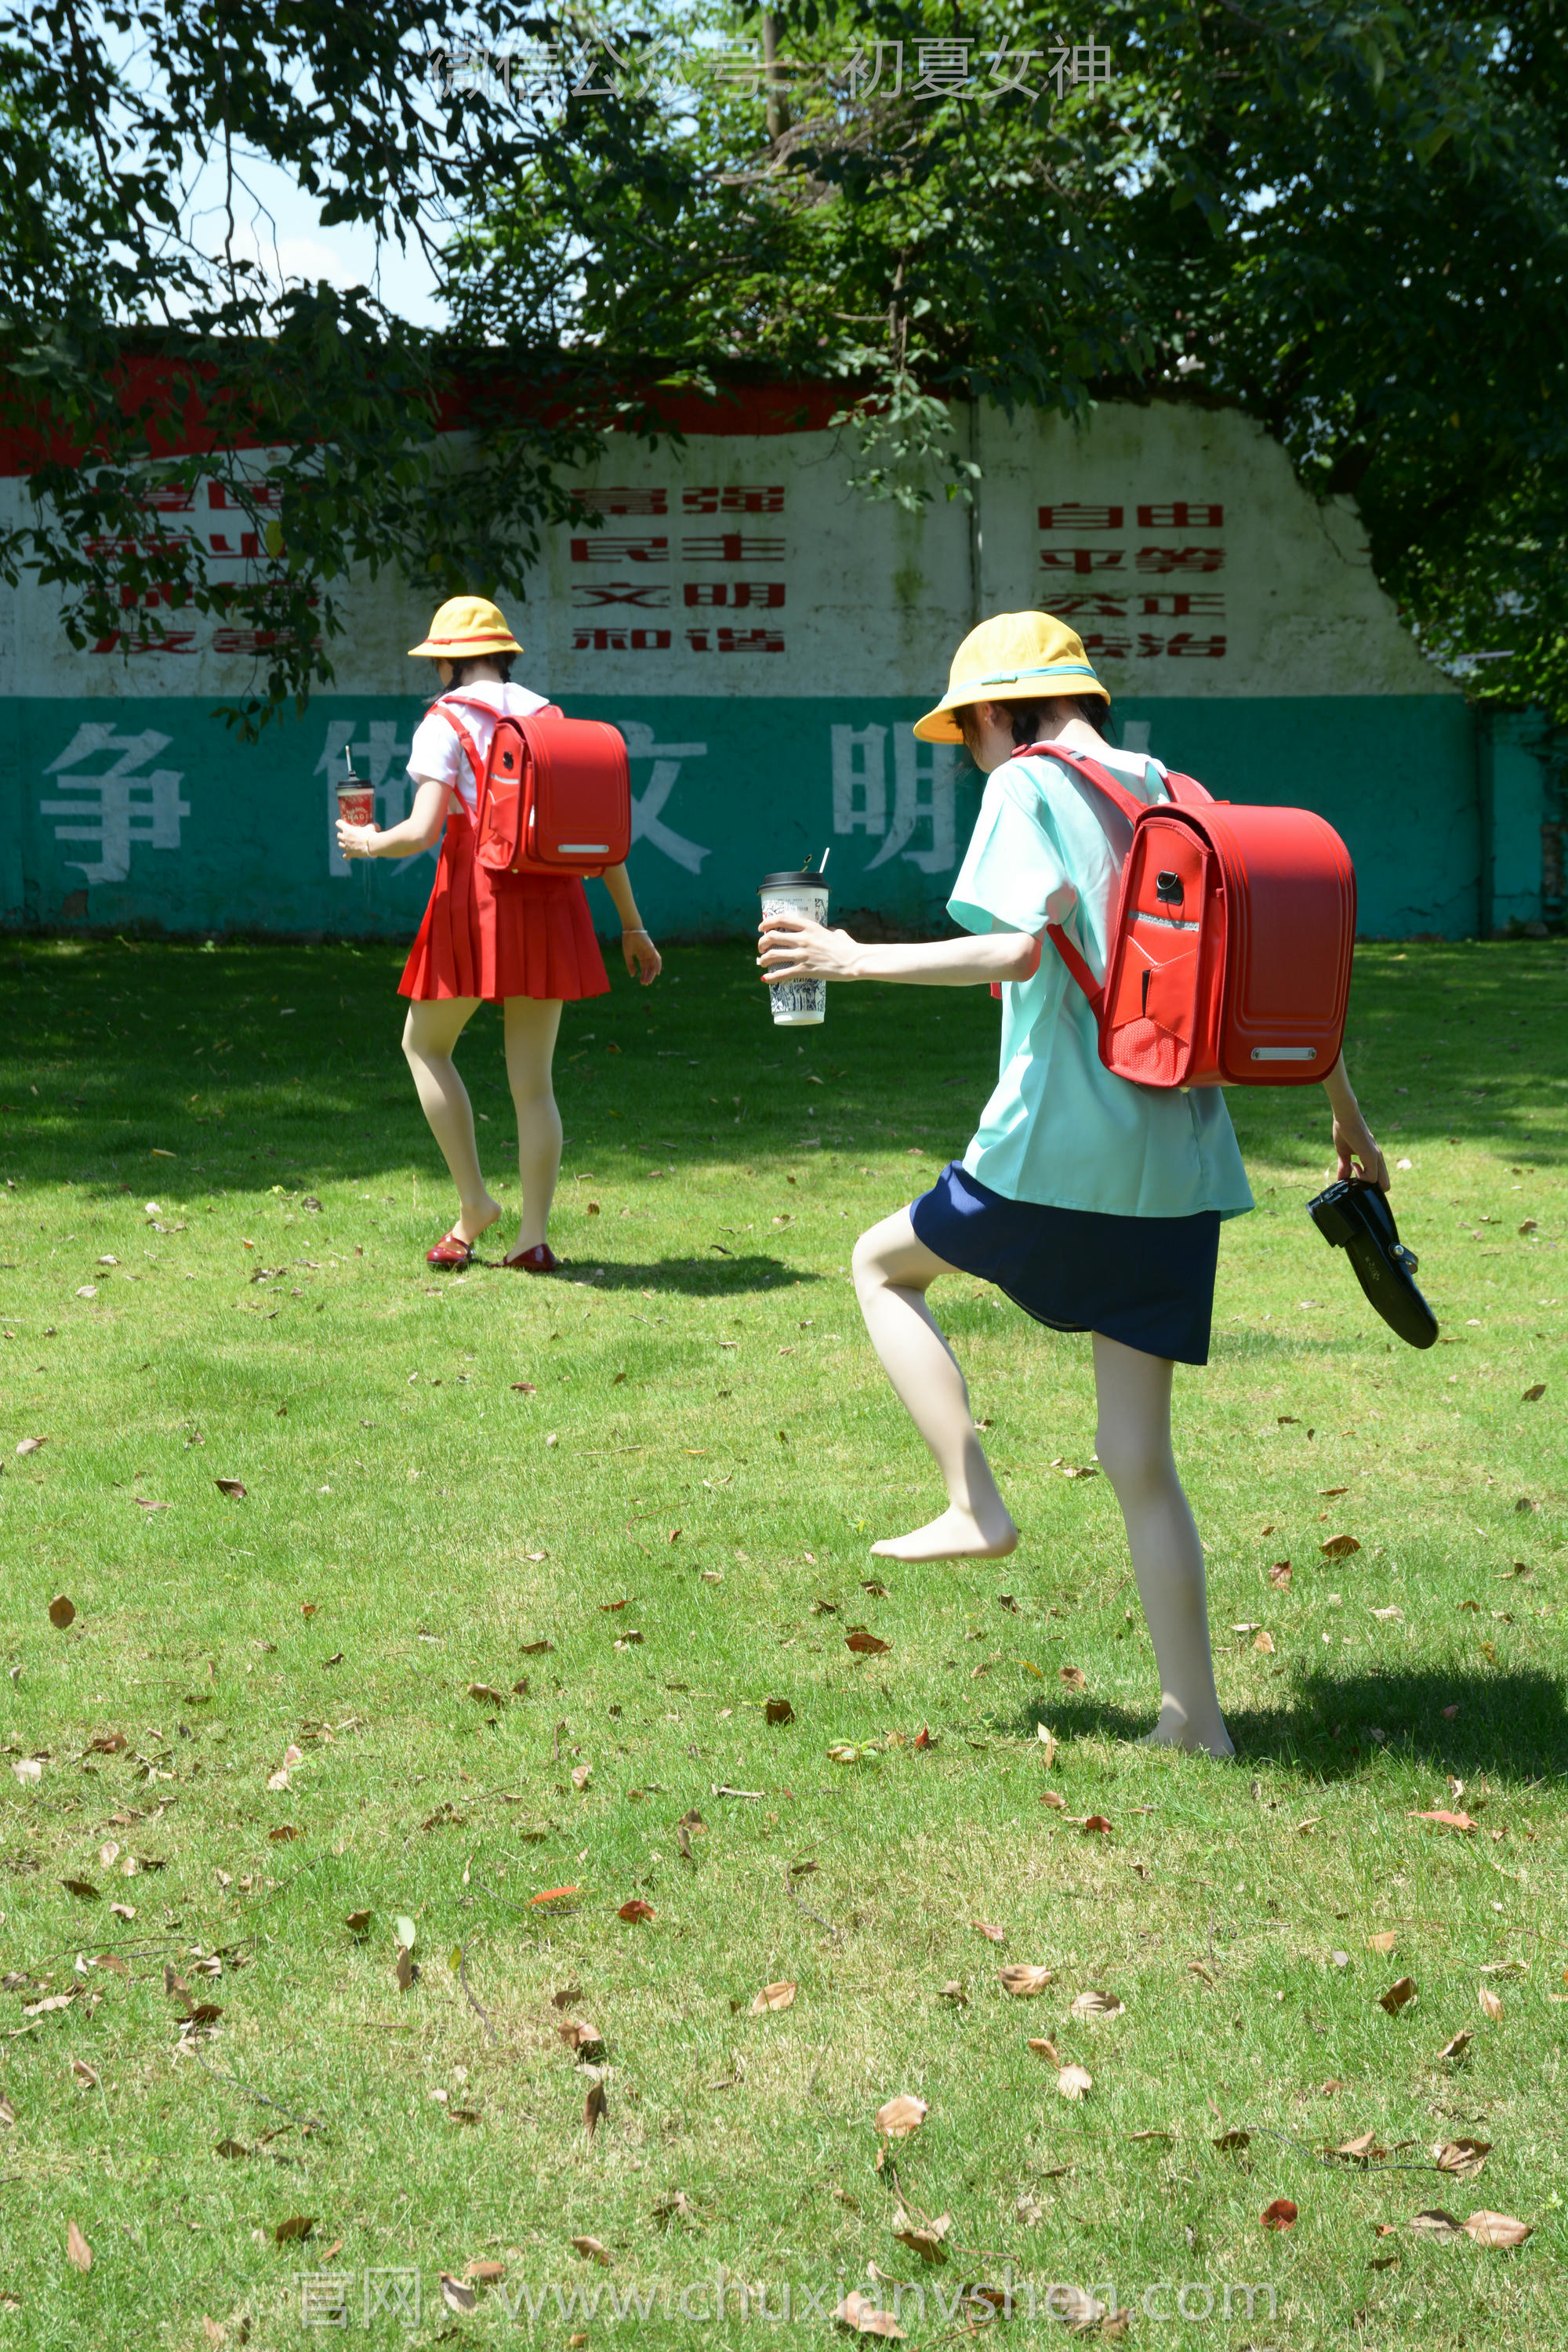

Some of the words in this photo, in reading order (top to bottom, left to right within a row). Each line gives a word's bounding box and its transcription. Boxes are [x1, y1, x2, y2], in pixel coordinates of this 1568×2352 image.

[570, 486, 785, 514] 富强
[1038, 502, 1223, 530] 自由
[570, 534, 786, 563] 民主
[1039, 546, 1226, 574] 平等
[572, 583, 786, 608] 文明
[1038, 593, 1225, 617] 公正
[572, 627, 786, 652] 和谐
